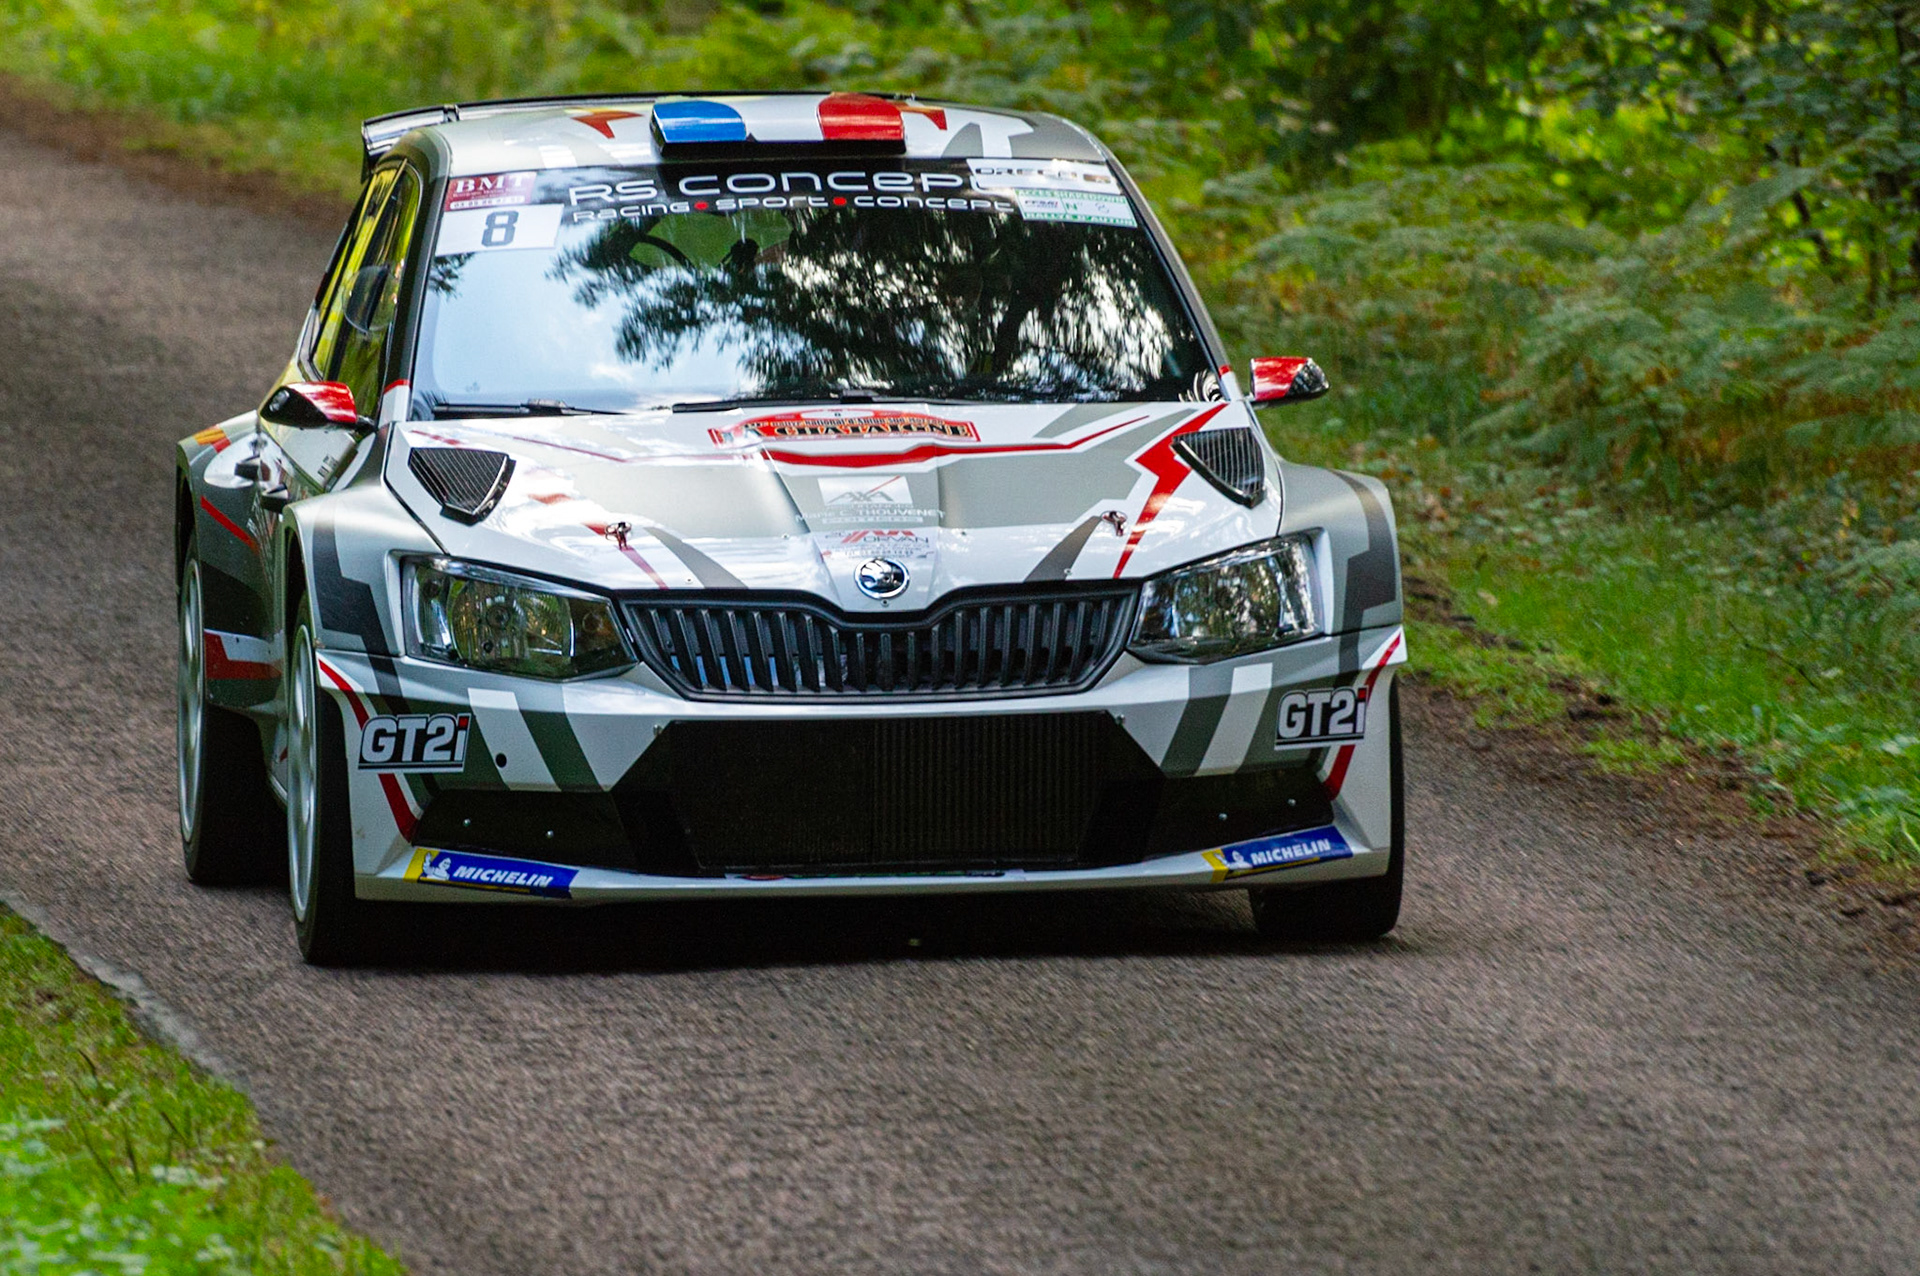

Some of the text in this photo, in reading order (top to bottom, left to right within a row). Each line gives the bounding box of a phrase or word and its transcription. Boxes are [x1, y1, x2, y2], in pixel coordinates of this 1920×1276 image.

[456, 173, 528, 193] BMT
[568, 179, 657, 206] RS
[481, 210, 519, 247] 8
[1278, 687, 1367, 739] GT2i
[361, 716, 468, 763] GT2i
[1251, 838, 1331, 866] MICHELIN
[453, 865, 553, 888] MICHELIN
